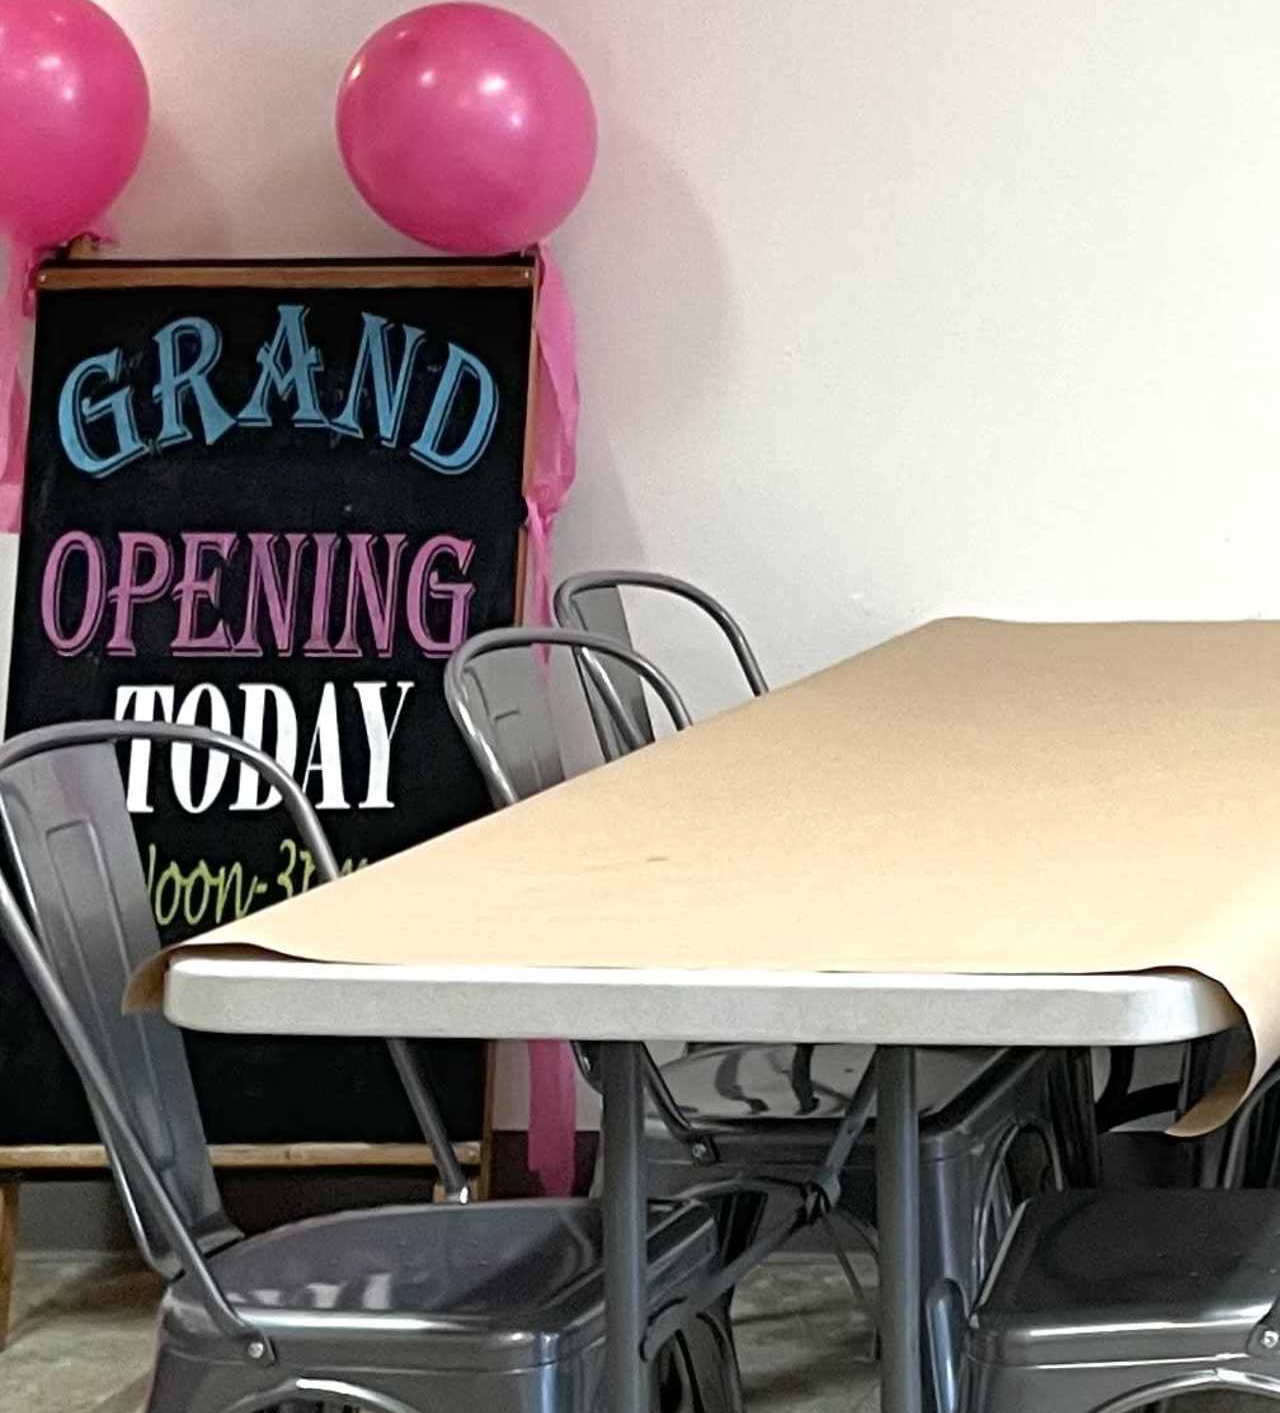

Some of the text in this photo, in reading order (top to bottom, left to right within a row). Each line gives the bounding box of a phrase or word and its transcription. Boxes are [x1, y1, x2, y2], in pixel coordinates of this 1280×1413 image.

[57, 303, 500, 479] GRAND
[41, 530, 478, 659] OPENING
[114, 681, 415, 814] TODAY
